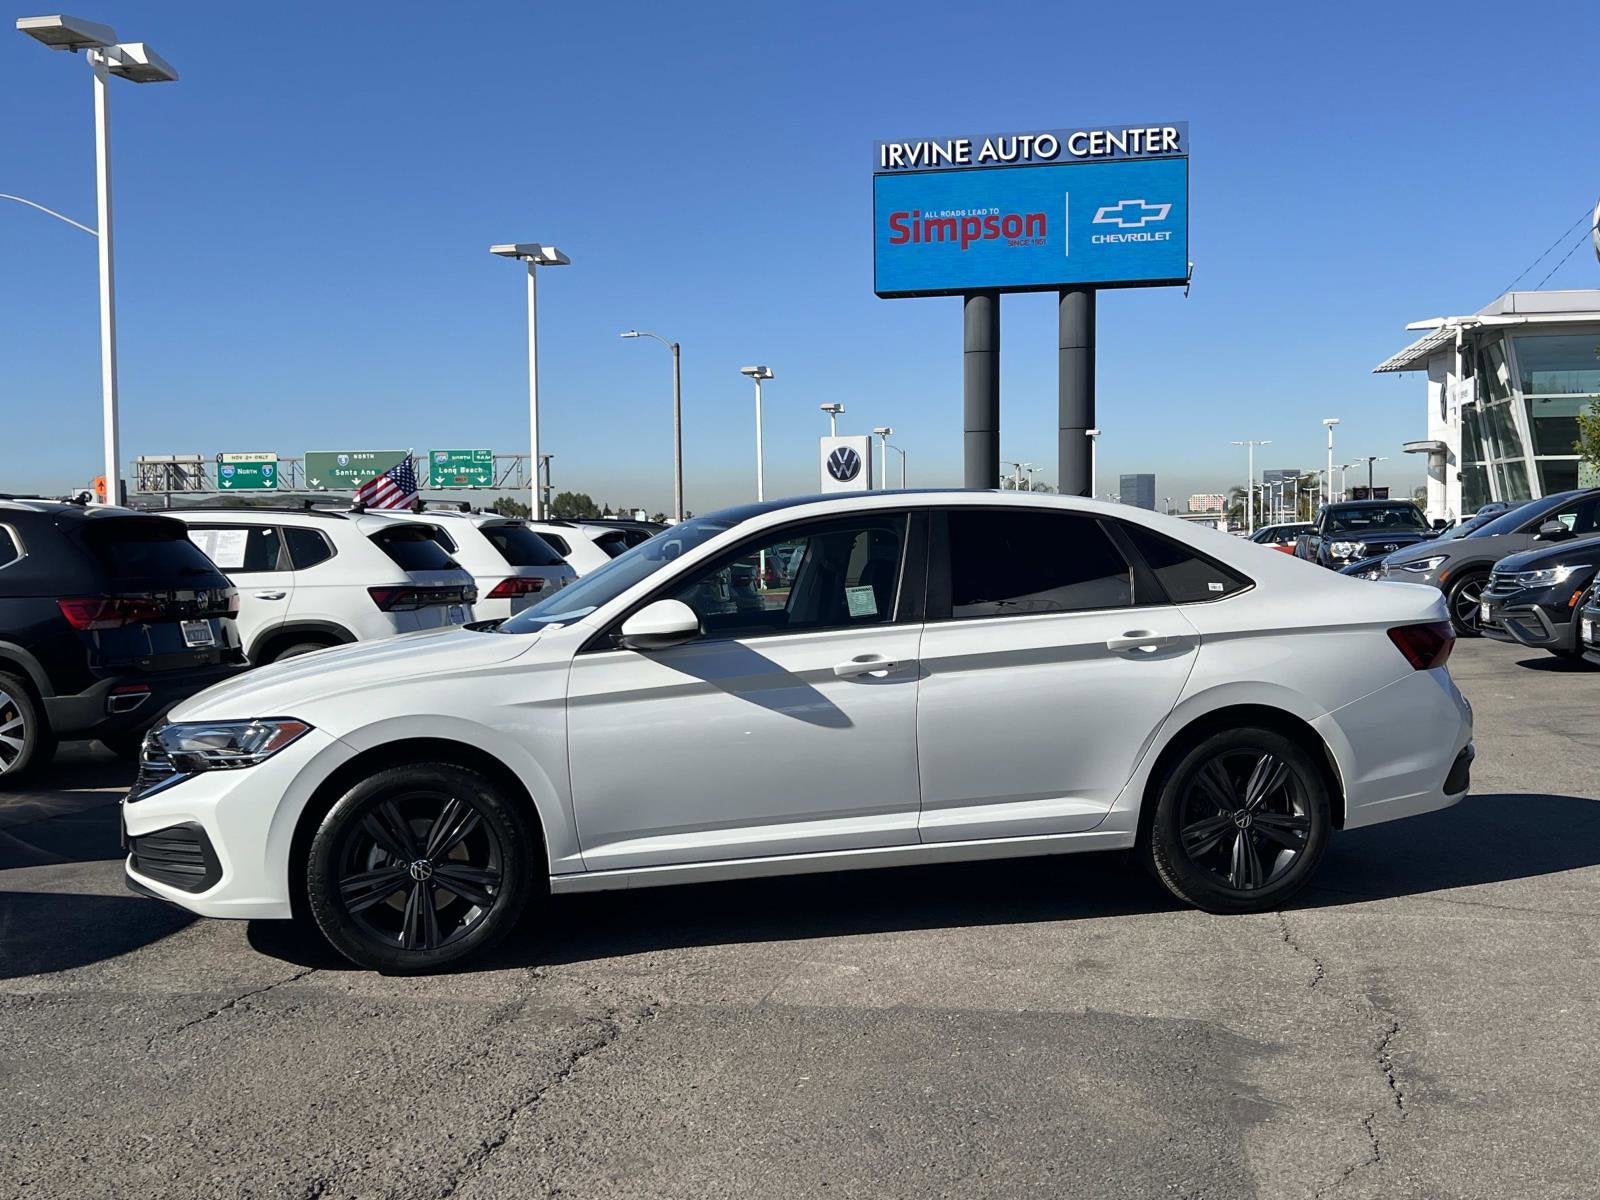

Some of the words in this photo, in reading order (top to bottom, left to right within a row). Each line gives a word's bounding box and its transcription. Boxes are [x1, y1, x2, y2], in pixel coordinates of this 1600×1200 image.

[881, 139, 969, 167] IRVINE
[978, 133, 1058, 162] AUTO
[1067, 127, 1179, 157] CENTER
[924, 210, 938, 219] ALL
[940, 209, 966, 218] ROADS
[967, 208, 988, 216] LEAD
[989, 207, 1000, 215] TO
[889, 209, 1047, 250] Simpson
[1007, 239, 1030, 248] SINCE
[1091, 231, 1173, 244] CHEVROLET
[438, 466, 457, 475] Long
